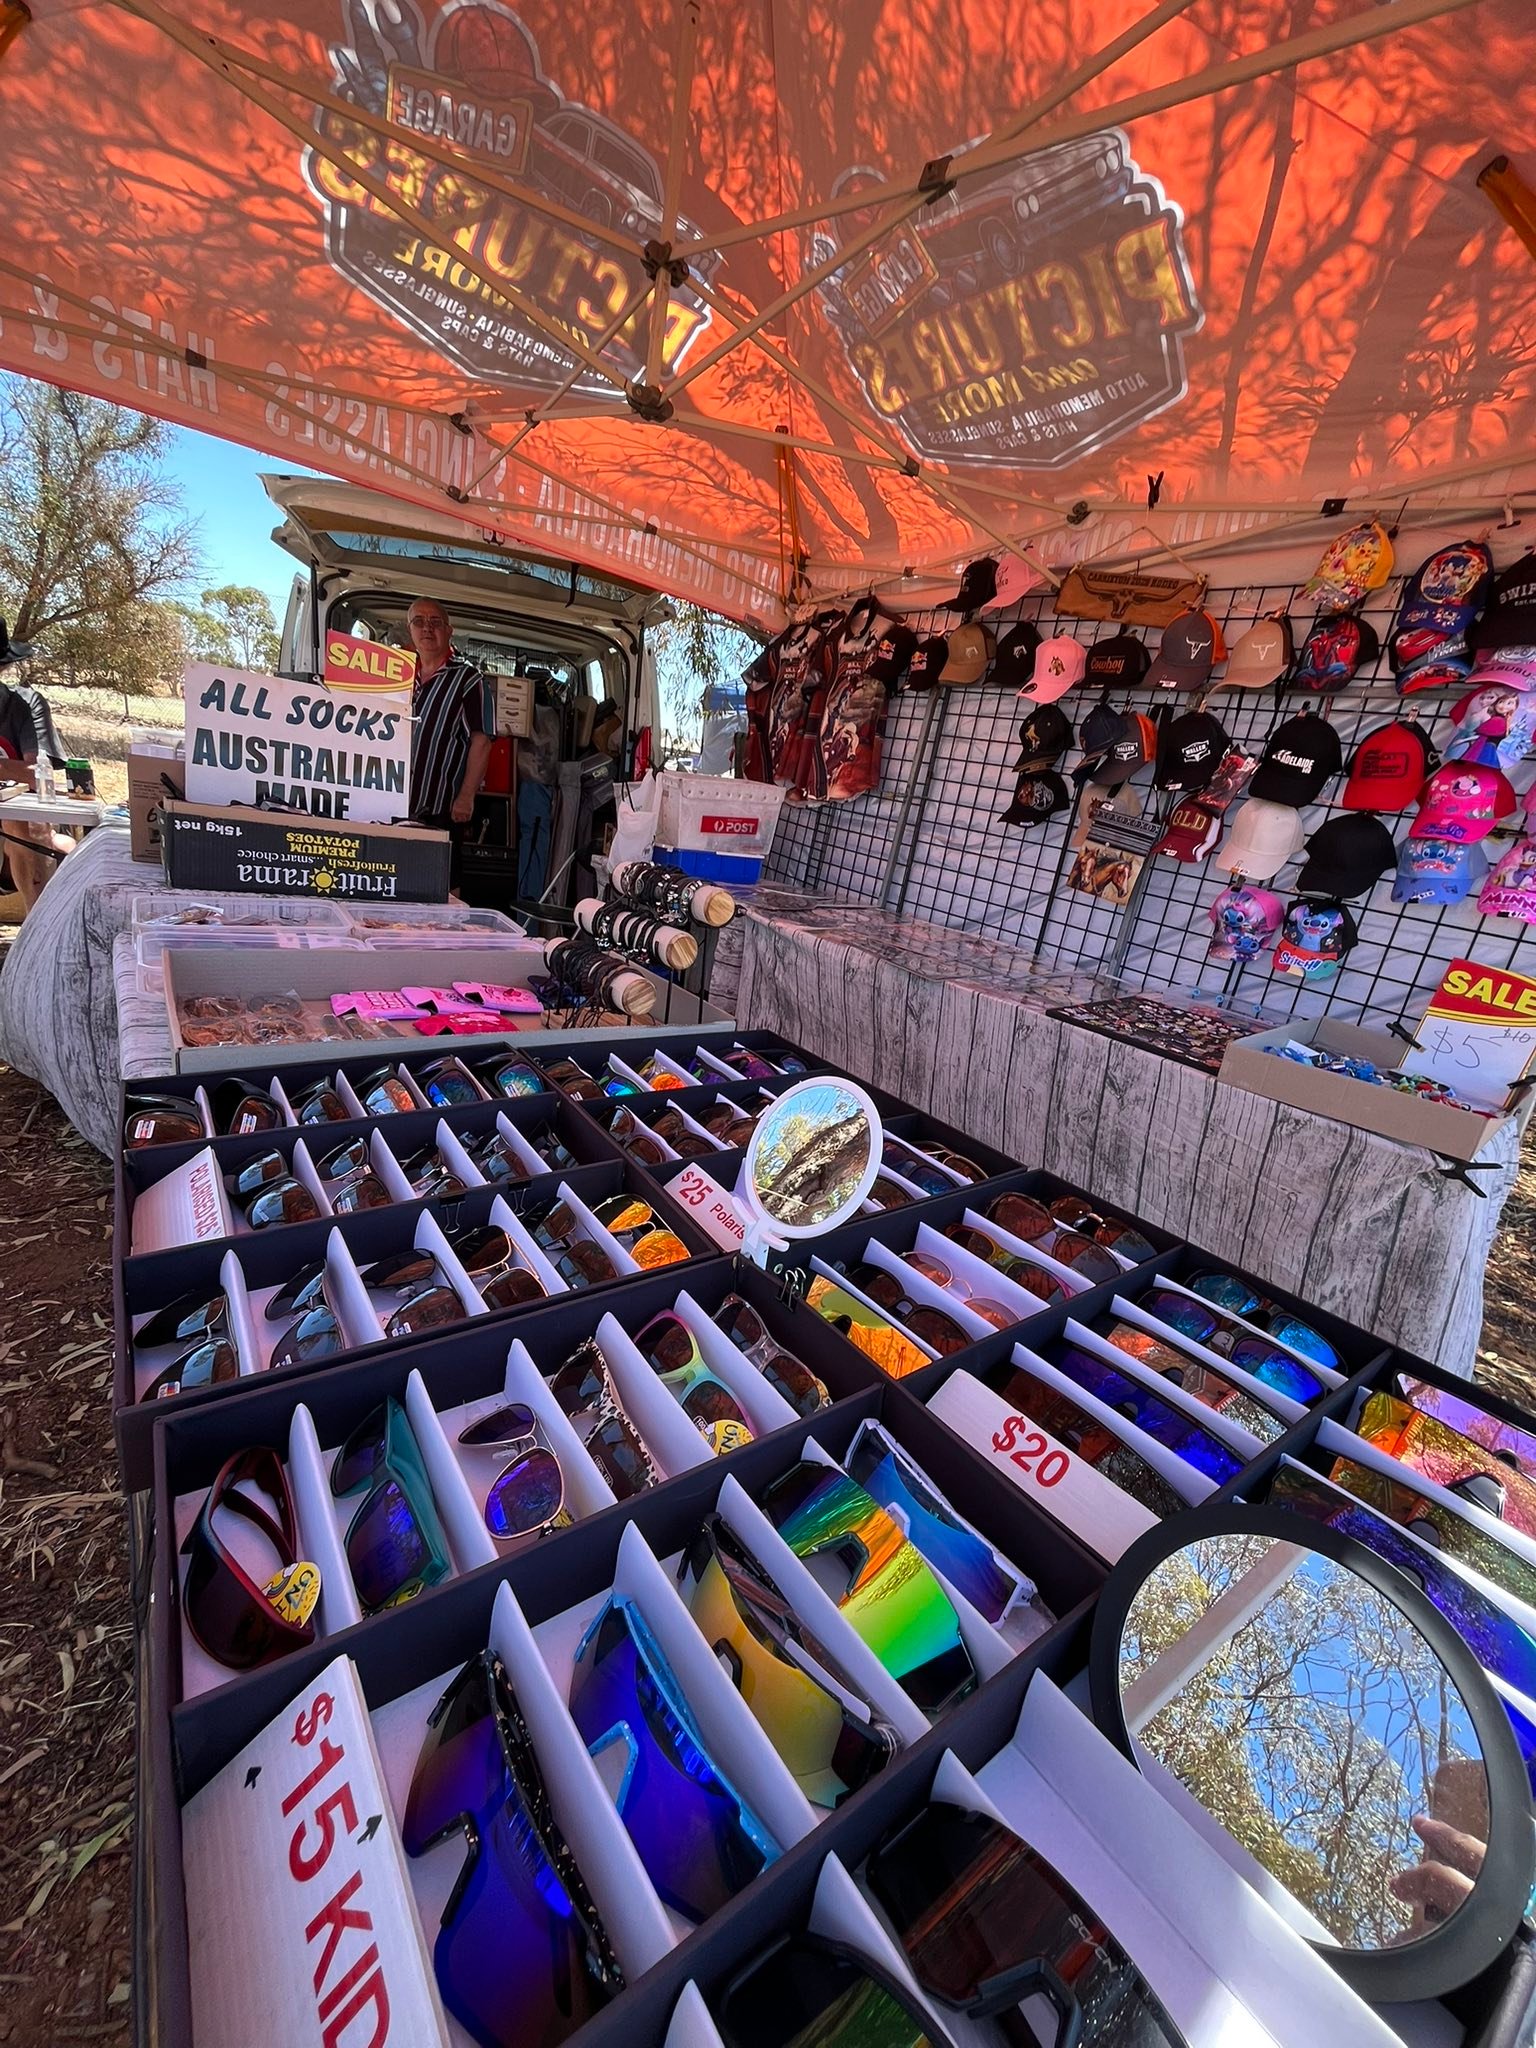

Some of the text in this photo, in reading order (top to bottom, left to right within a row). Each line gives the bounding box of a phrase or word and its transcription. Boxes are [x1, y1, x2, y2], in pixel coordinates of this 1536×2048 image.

[327, 642, 404, 682] SALE
[200, 678, 400, 741] ALL SOCKS
[192, 728, 405, 793] AUSTRALIAN
[255, 780, 350, 819] MADE
[174, 819, 243, 837] 15kg net
[726, 822, 756, 833] POST
[1172, 810, 1207, 830] QLD
[237, 849, 280, 863] choice
[286, 832, 360, 849] POTATOES
[290, 843, 357, 858] PREMIUM
[328, 858, 396, 873] Fruitofresh
[1442, 970, 1536, 1017] SALE
[1430, 1025, 1502, 1068] $5
[189, 1162, 217, 1220] POLARISED
[679, 1171, 745, 1240] $25 Polaris
[992, 1416, 1070, 1487] $20
[281, 1692, 390, 2048] $15 KID
